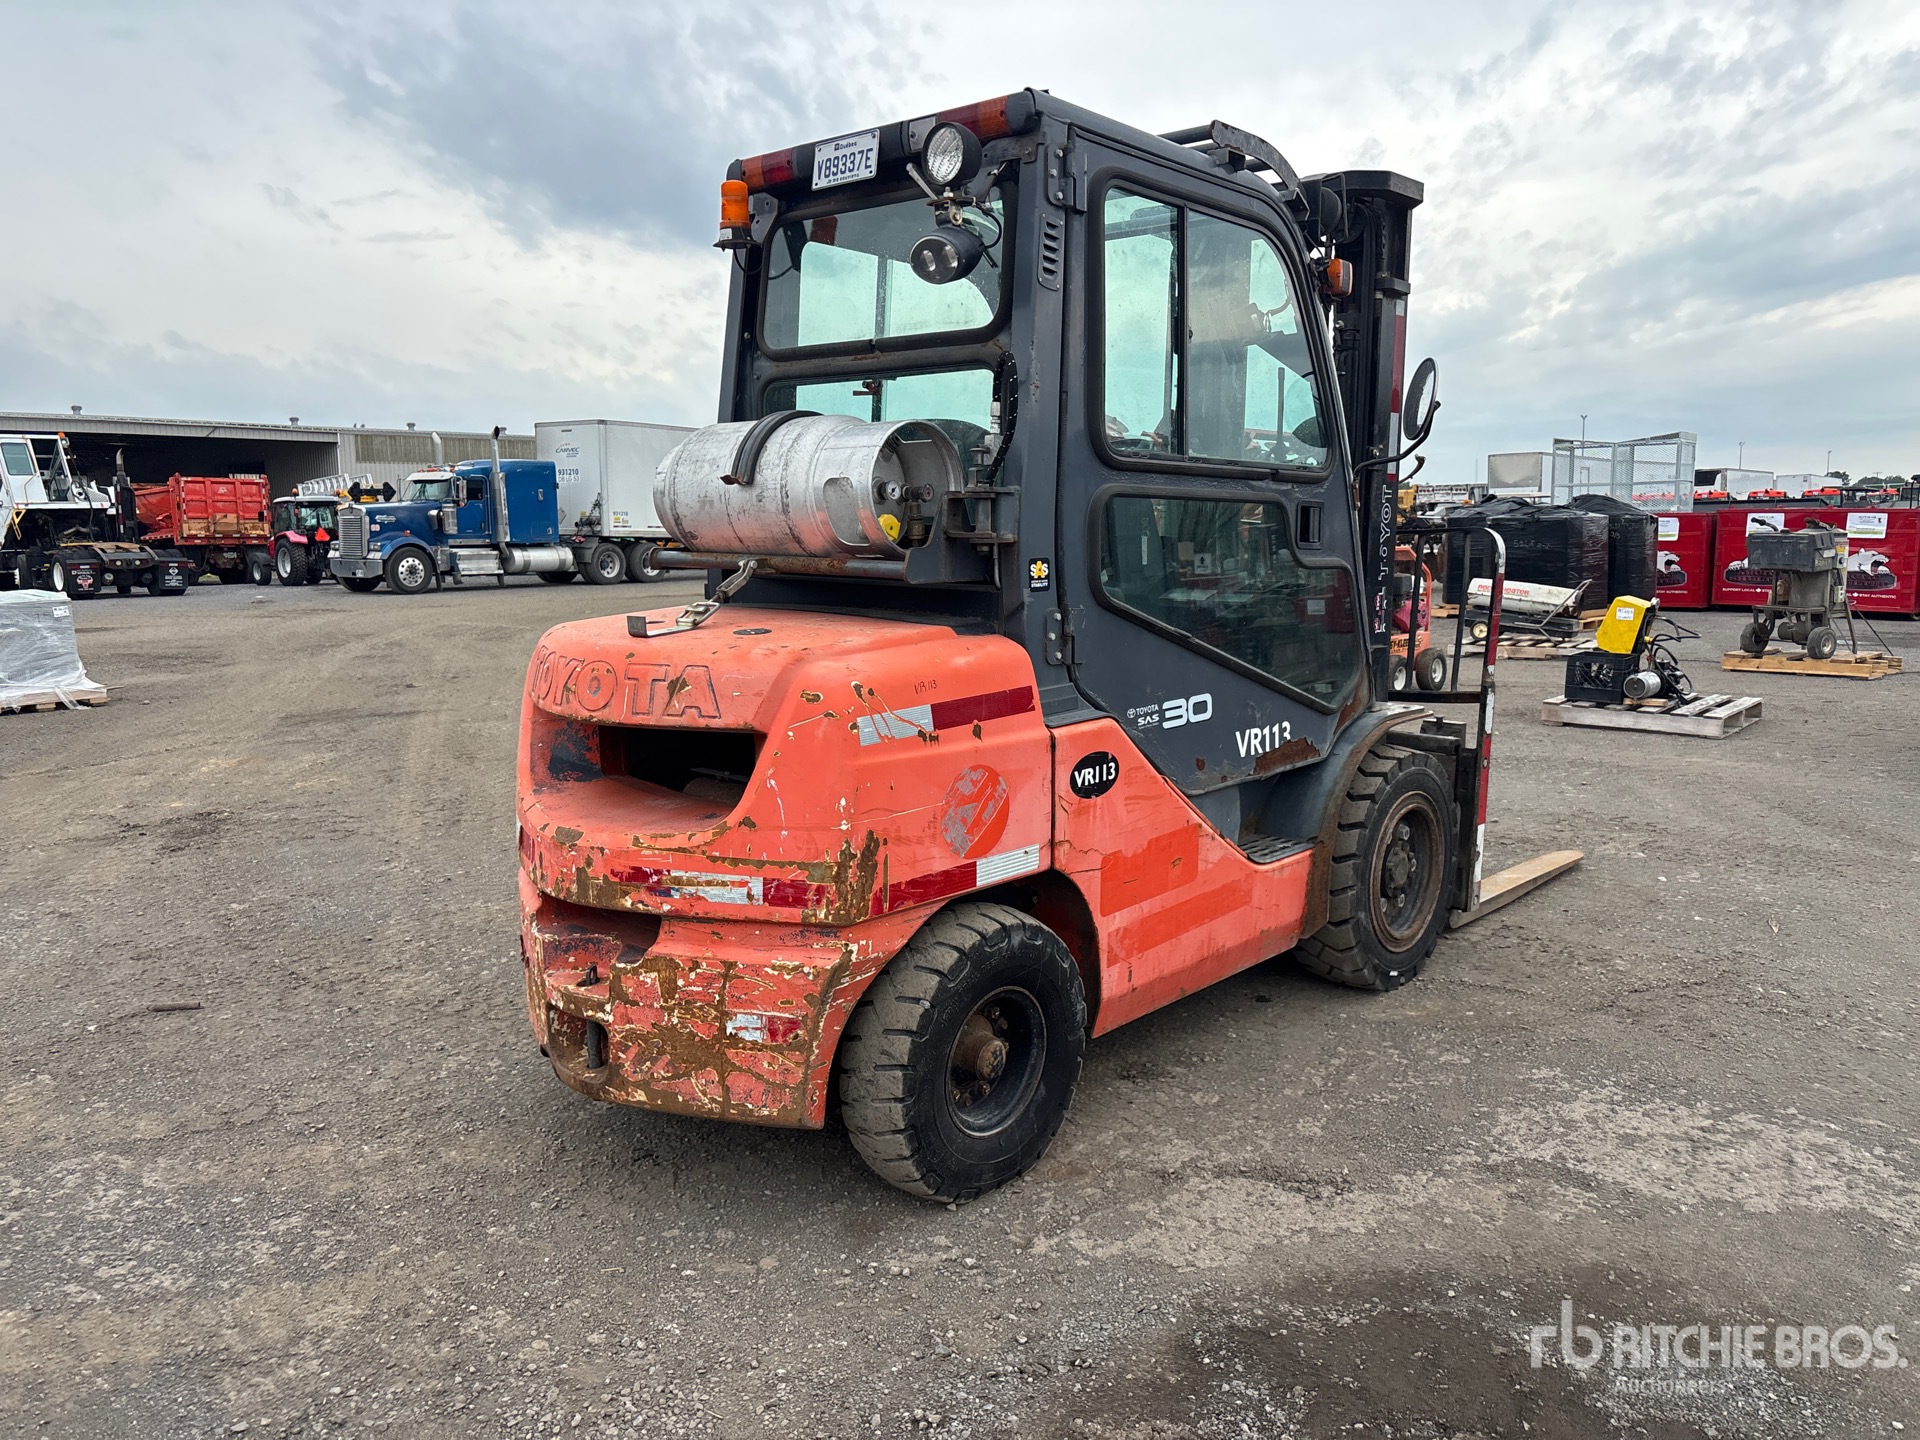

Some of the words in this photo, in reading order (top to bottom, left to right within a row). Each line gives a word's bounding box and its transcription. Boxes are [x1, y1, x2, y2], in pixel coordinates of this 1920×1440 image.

[840, 141, 857, 150] Québec
[557, 468, 579, 476] 931210
[1029, 560, 1049, 579] SAS
[1135, 703, 1159, 716] TOYOTA
[1162, 692, 1213, 730] 30
[1137, 713, 1160, 726] SAS
[1235, 720, 1292, 758] VR113
